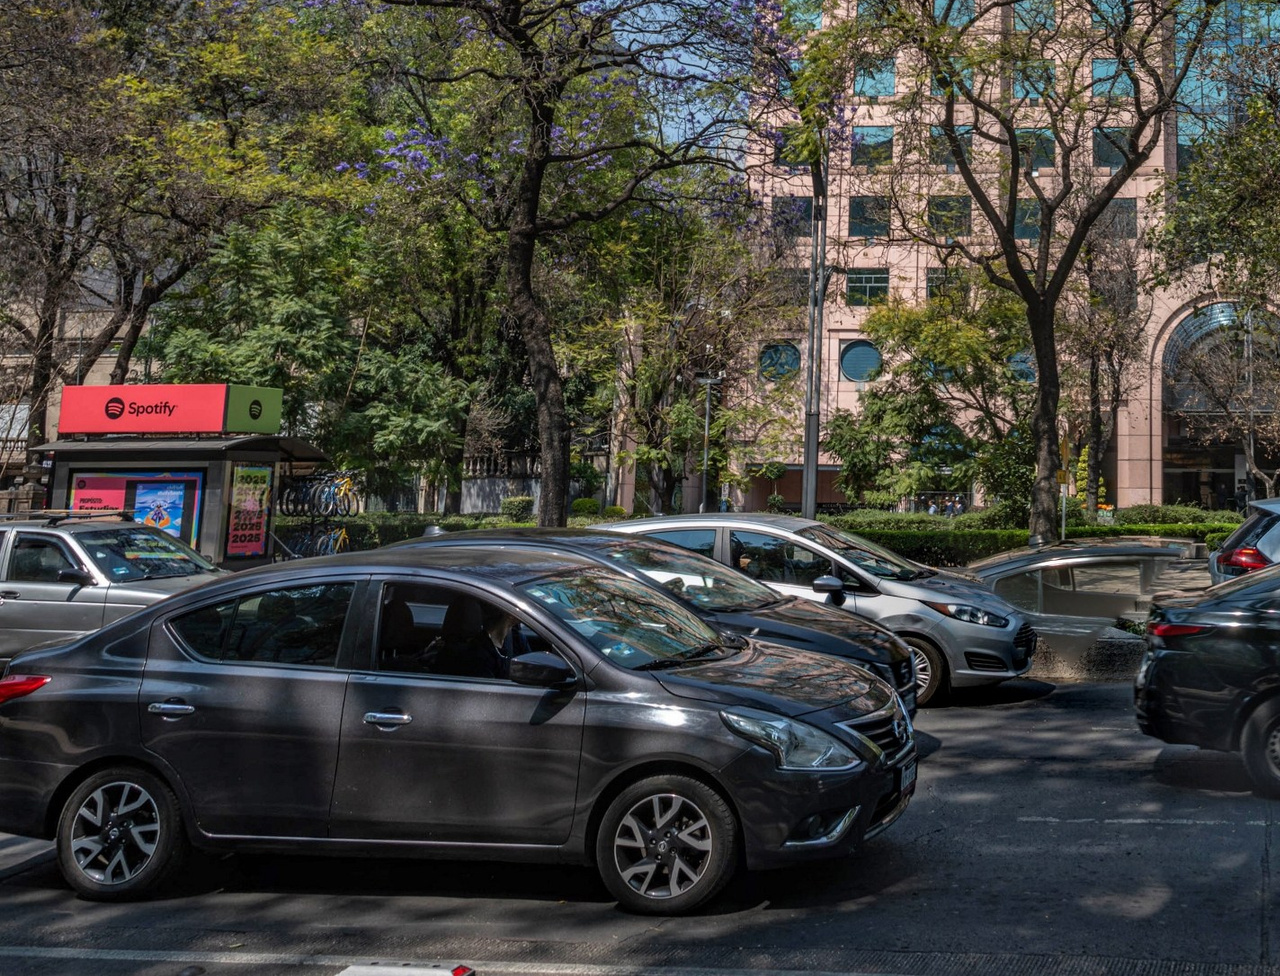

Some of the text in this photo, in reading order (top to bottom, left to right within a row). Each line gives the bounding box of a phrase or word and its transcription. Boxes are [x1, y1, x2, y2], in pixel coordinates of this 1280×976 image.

[128, 402, 176, 417] Spotify
[232, 522, 262, 532] 2025
[231, 533, 261, 543] 2025
